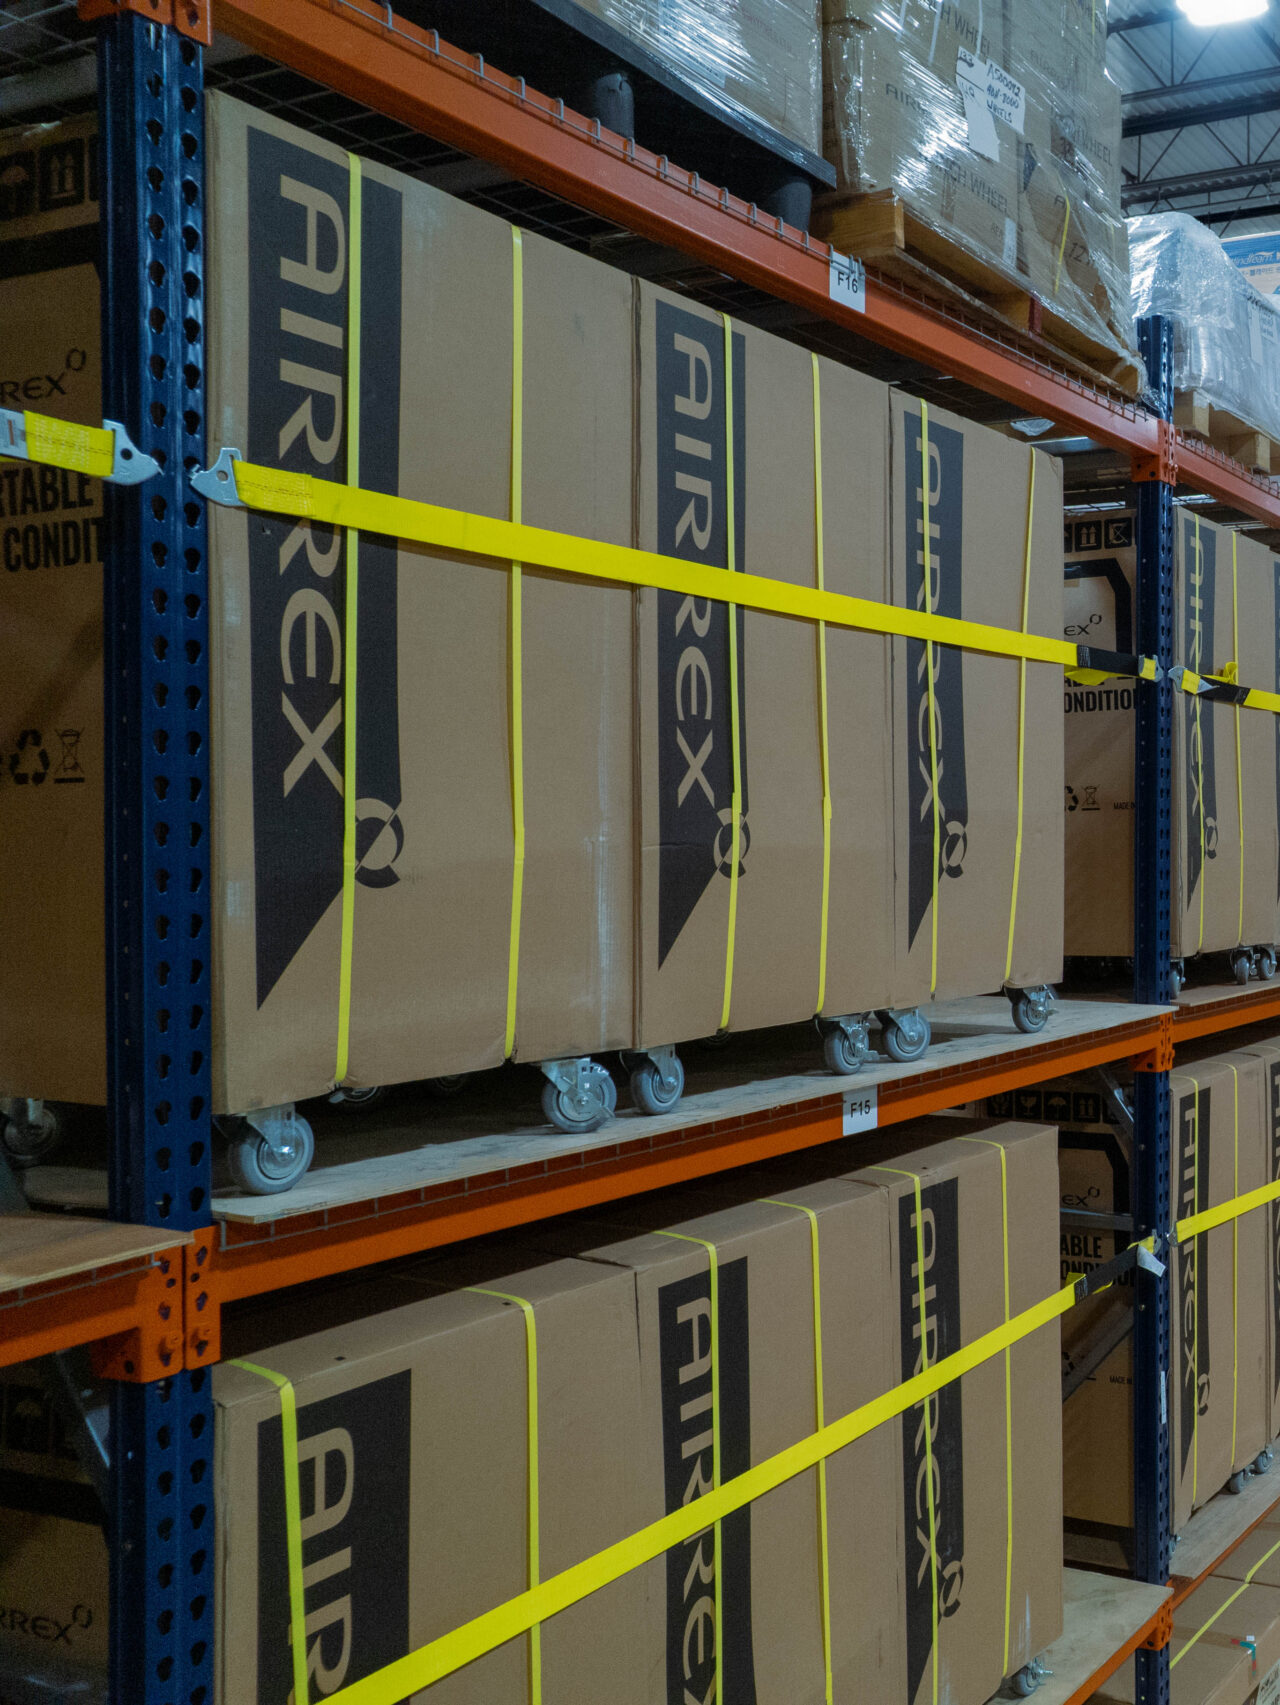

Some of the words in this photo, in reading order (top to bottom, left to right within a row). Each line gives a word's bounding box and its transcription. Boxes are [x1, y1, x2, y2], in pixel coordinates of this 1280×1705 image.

[837, 271, 858, 293] F16
[0, 462, 94, 516] TABLE
[1064, 687, 1136, 714] ONDITIO
[850, 1099, 871, 1118] F15
